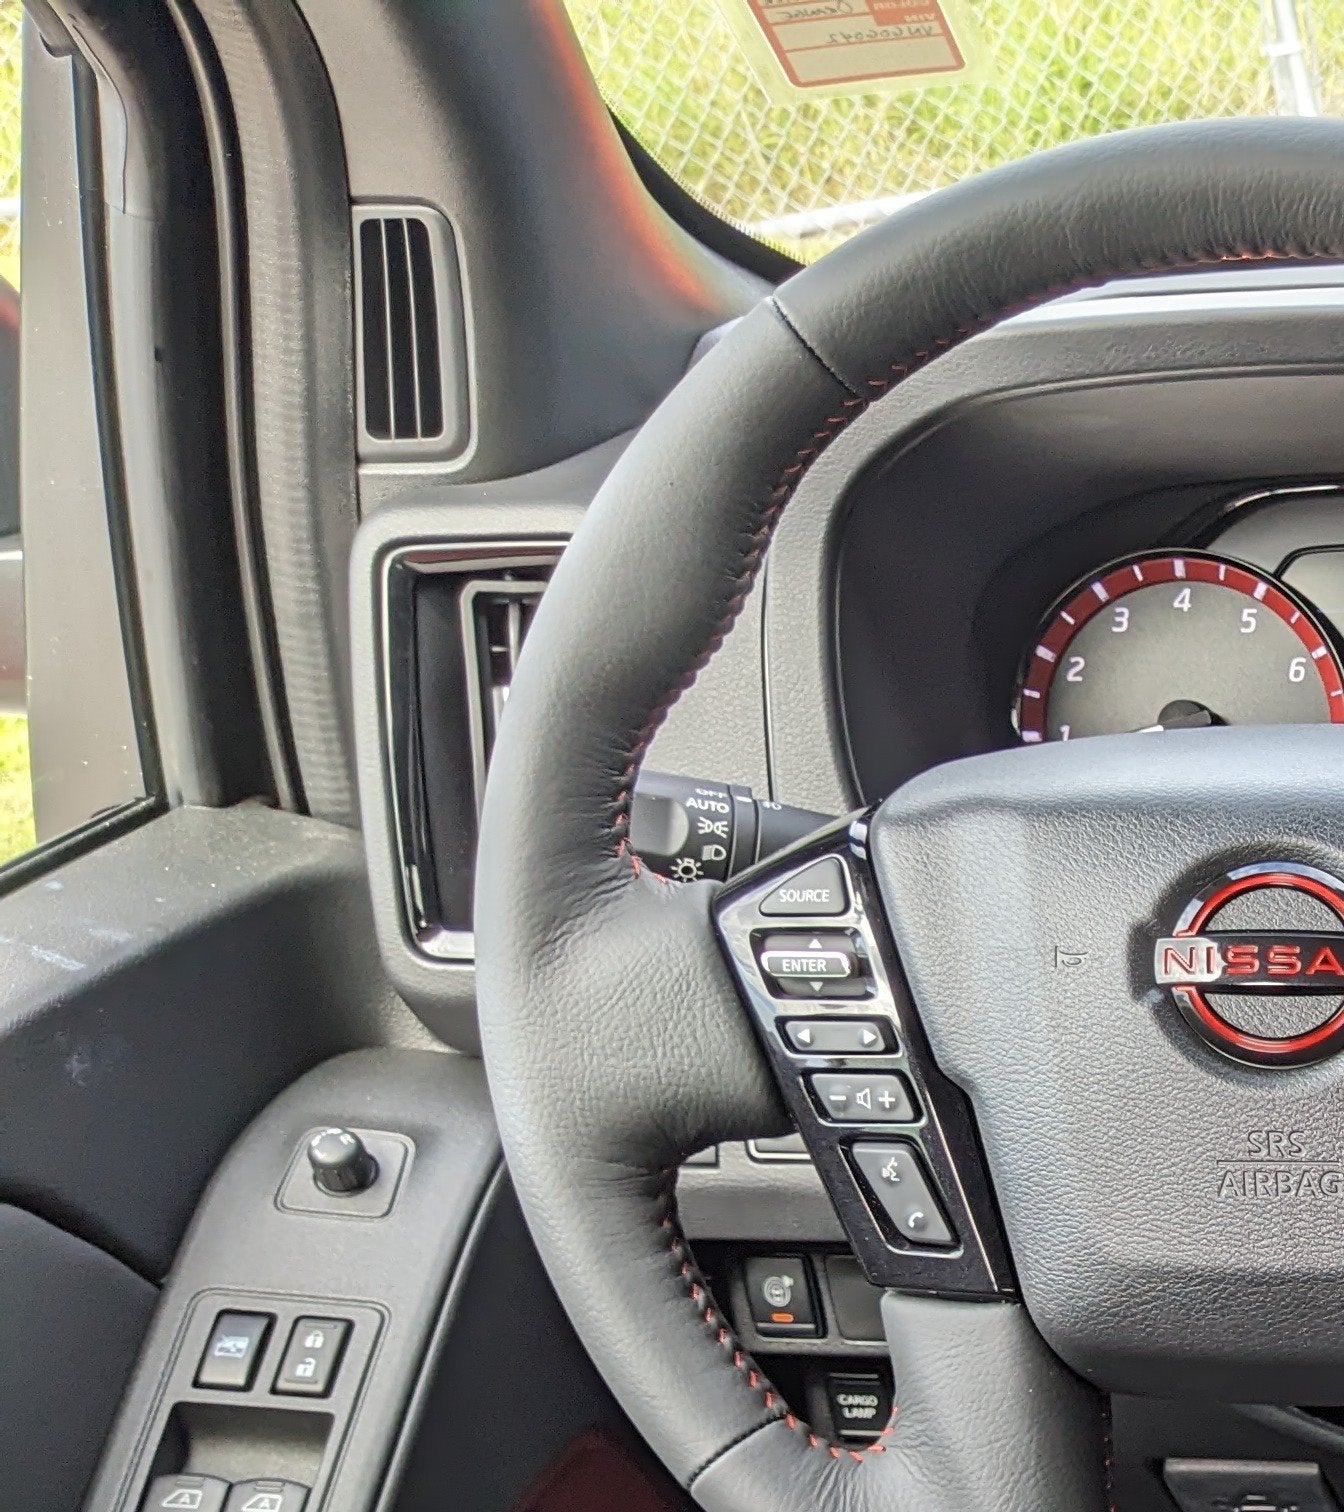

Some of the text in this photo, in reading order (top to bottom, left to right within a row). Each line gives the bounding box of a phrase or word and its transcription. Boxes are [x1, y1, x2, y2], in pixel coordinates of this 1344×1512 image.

[1173, 588, 1193, 612] 4
[1111, 607, 1130, 633] 3
[1240, 608, 1259, 634] 5
[1066, 657, 1086, 683] 2
[1288, 657, 1307, 683] 6
[685, 796, 731, 814] AUTO
[779, 888, 830, 904] SOURCE
[782, 958, 827, 974] ENTER
[1246, 1130, 1307, 1158] SRS
[1218, 1170, 1344, 1199] AIRBAG
[836, 1394, 878, 1407] CARGO
[842, 1407, 877, 1419] LAMP
